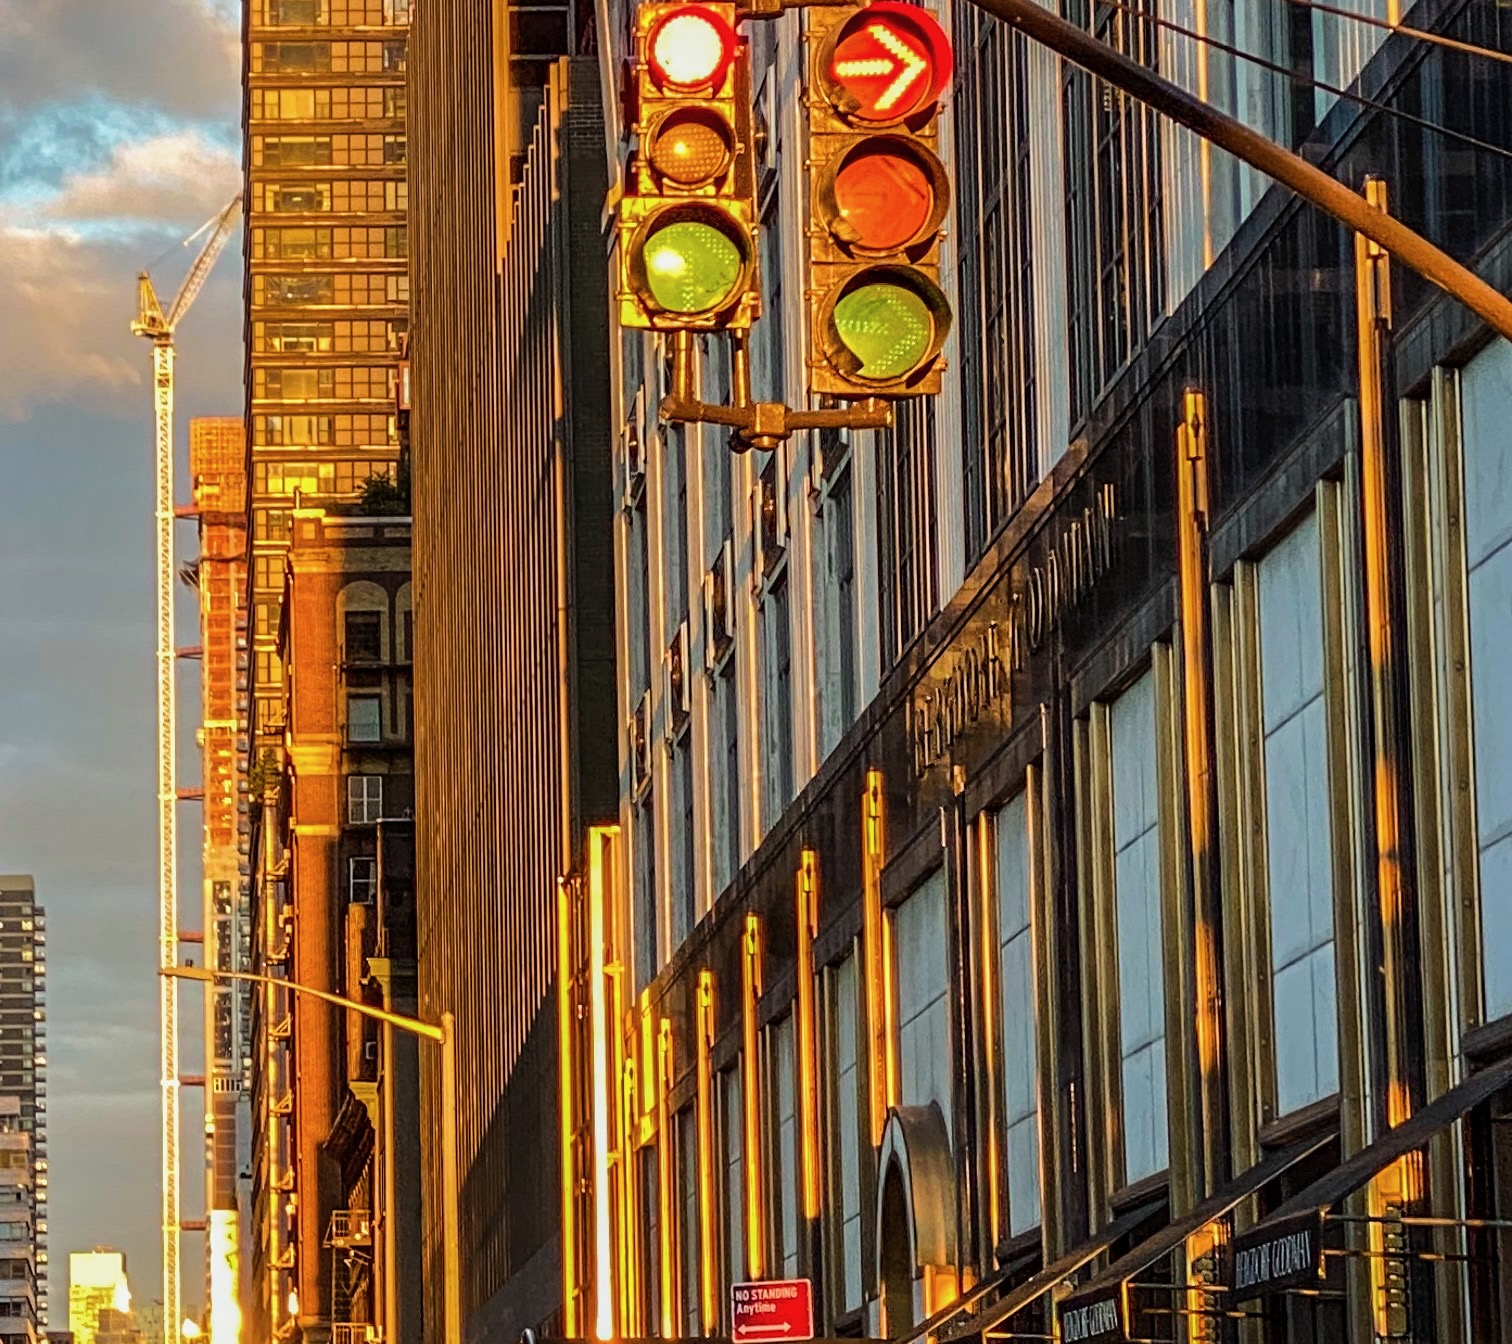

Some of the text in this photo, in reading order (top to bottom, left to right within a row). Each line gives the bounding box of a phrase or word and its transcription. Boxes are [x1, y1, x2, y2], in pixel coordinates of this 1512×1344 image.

[735, 1286, 798, 1302] NO STANDING
[736, 1301, 777, 1316] Anytime
